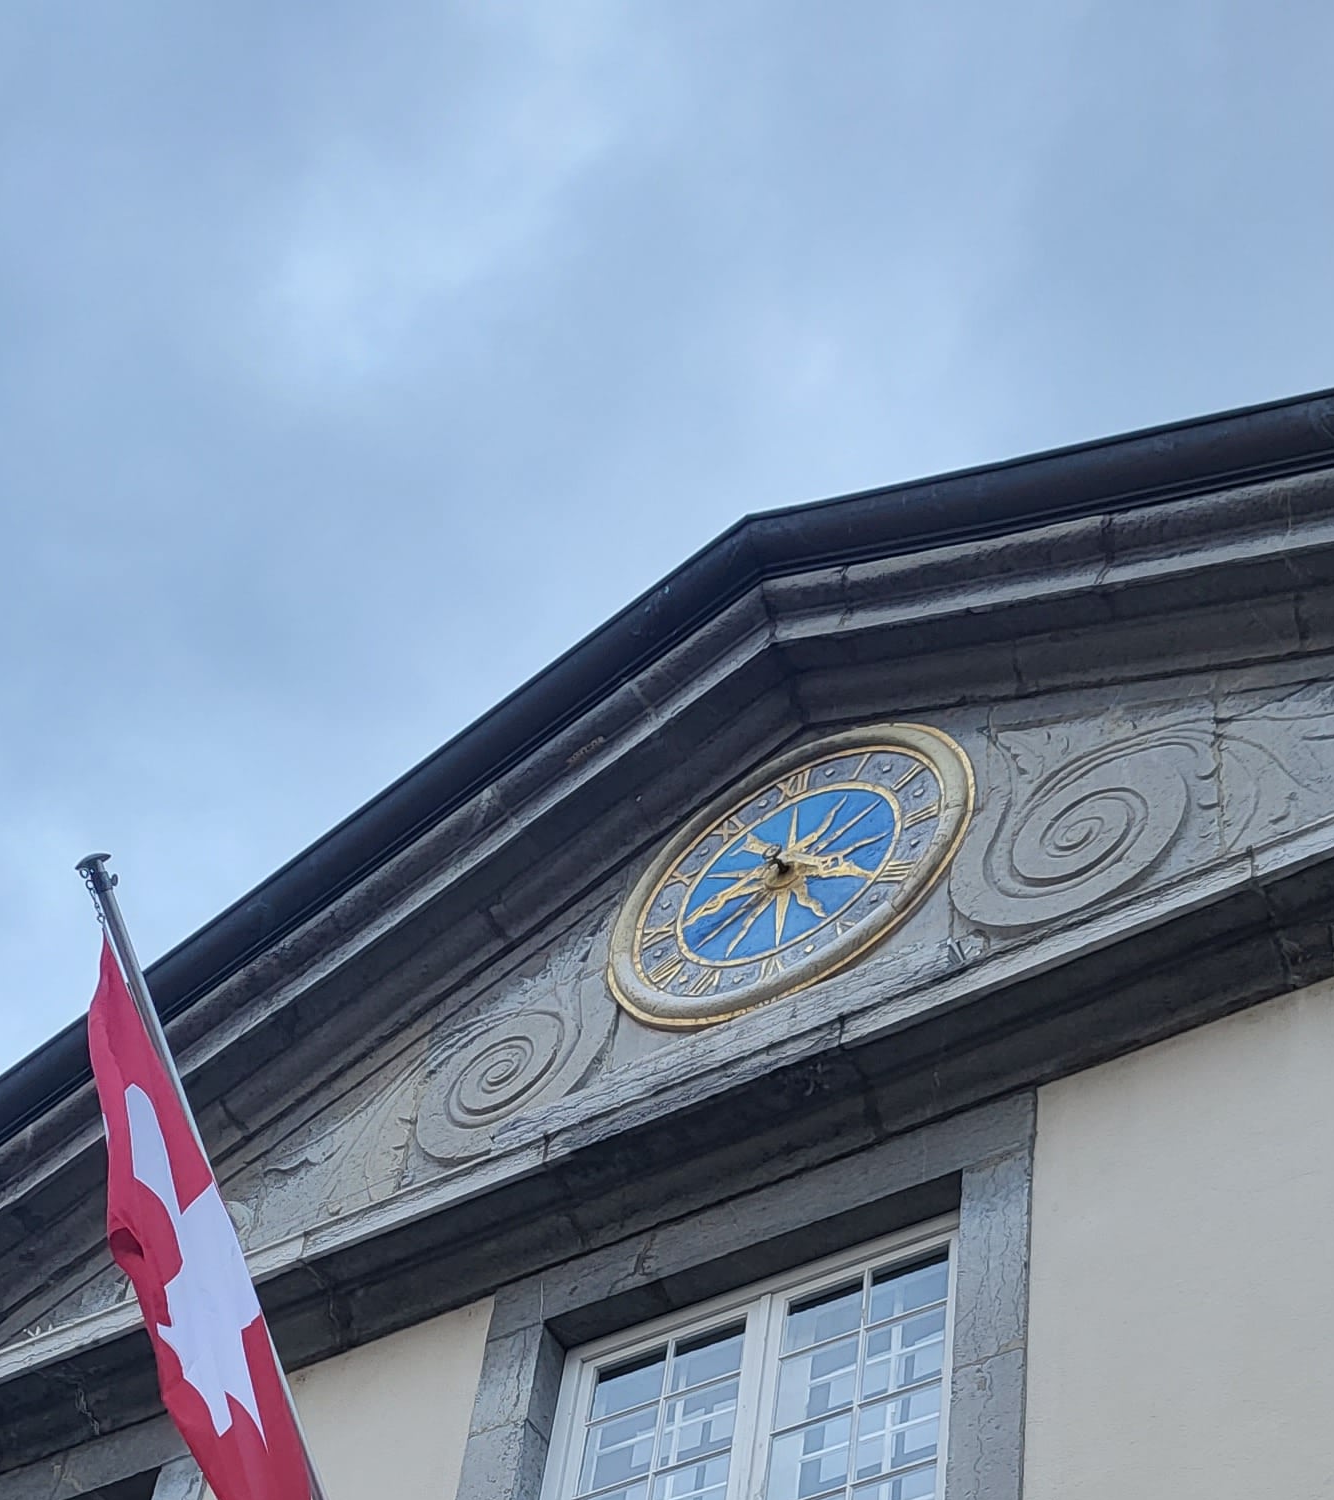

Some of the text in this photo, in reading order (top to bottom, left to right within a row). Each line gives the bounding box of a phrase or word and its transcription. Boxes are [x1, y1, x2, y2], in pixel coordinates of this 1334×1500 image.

[775, 768, 812, 803] XII
[890, 762, 927, 792] II
[709, 814, 746, 845] XI
[903, 801, 939, 830] III
[665, 867, 702, 888] X
